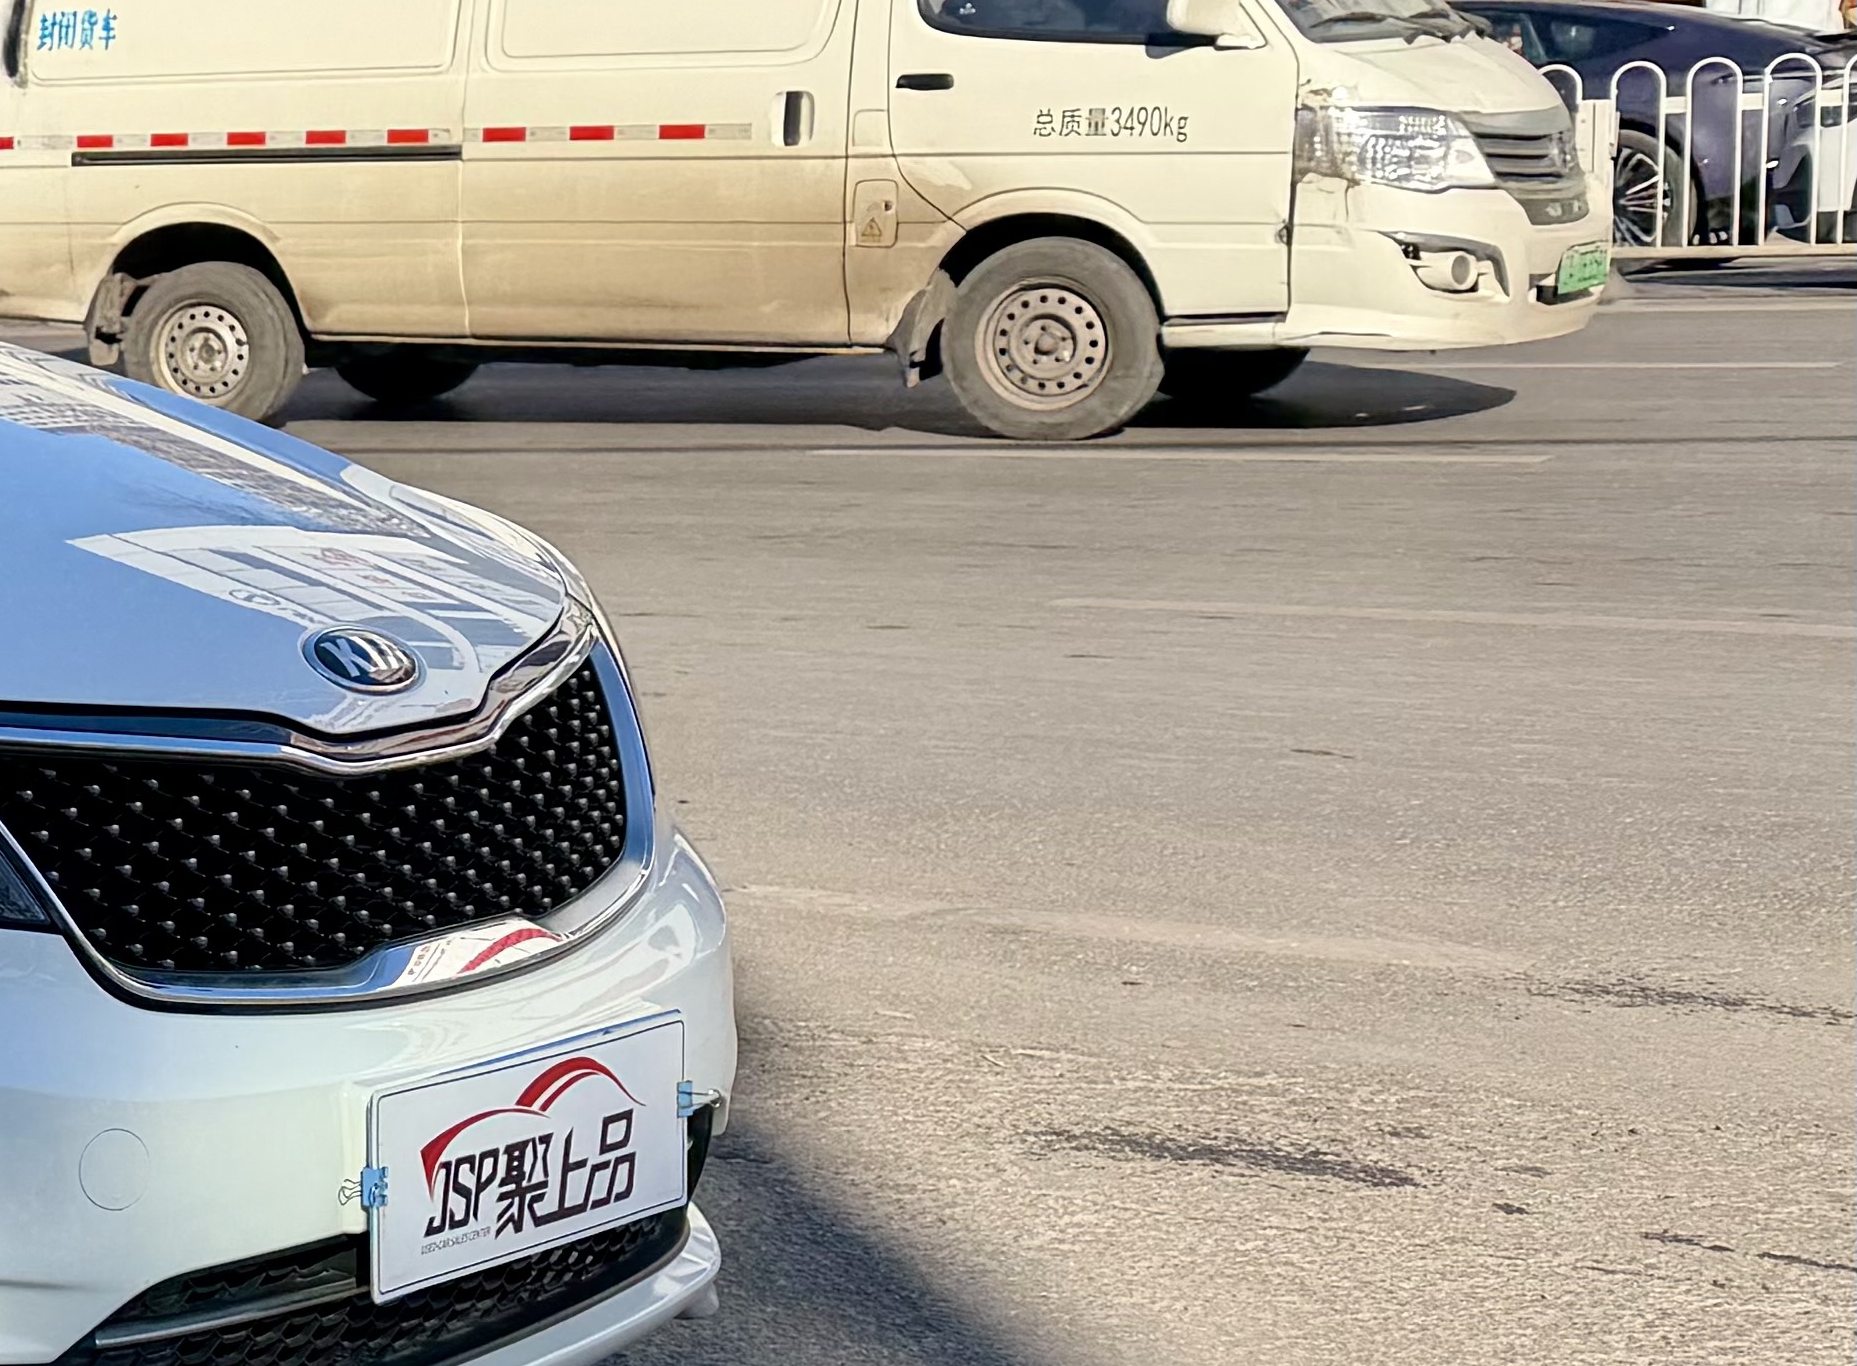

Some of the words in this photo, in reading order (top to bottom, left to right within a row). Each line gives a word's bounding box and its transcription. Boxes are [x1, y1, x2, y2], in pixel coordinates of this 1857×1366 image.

[37, 8, 118, 51] 封闭货车
[1033, 106, 1189, 143] 总质量3490kg
